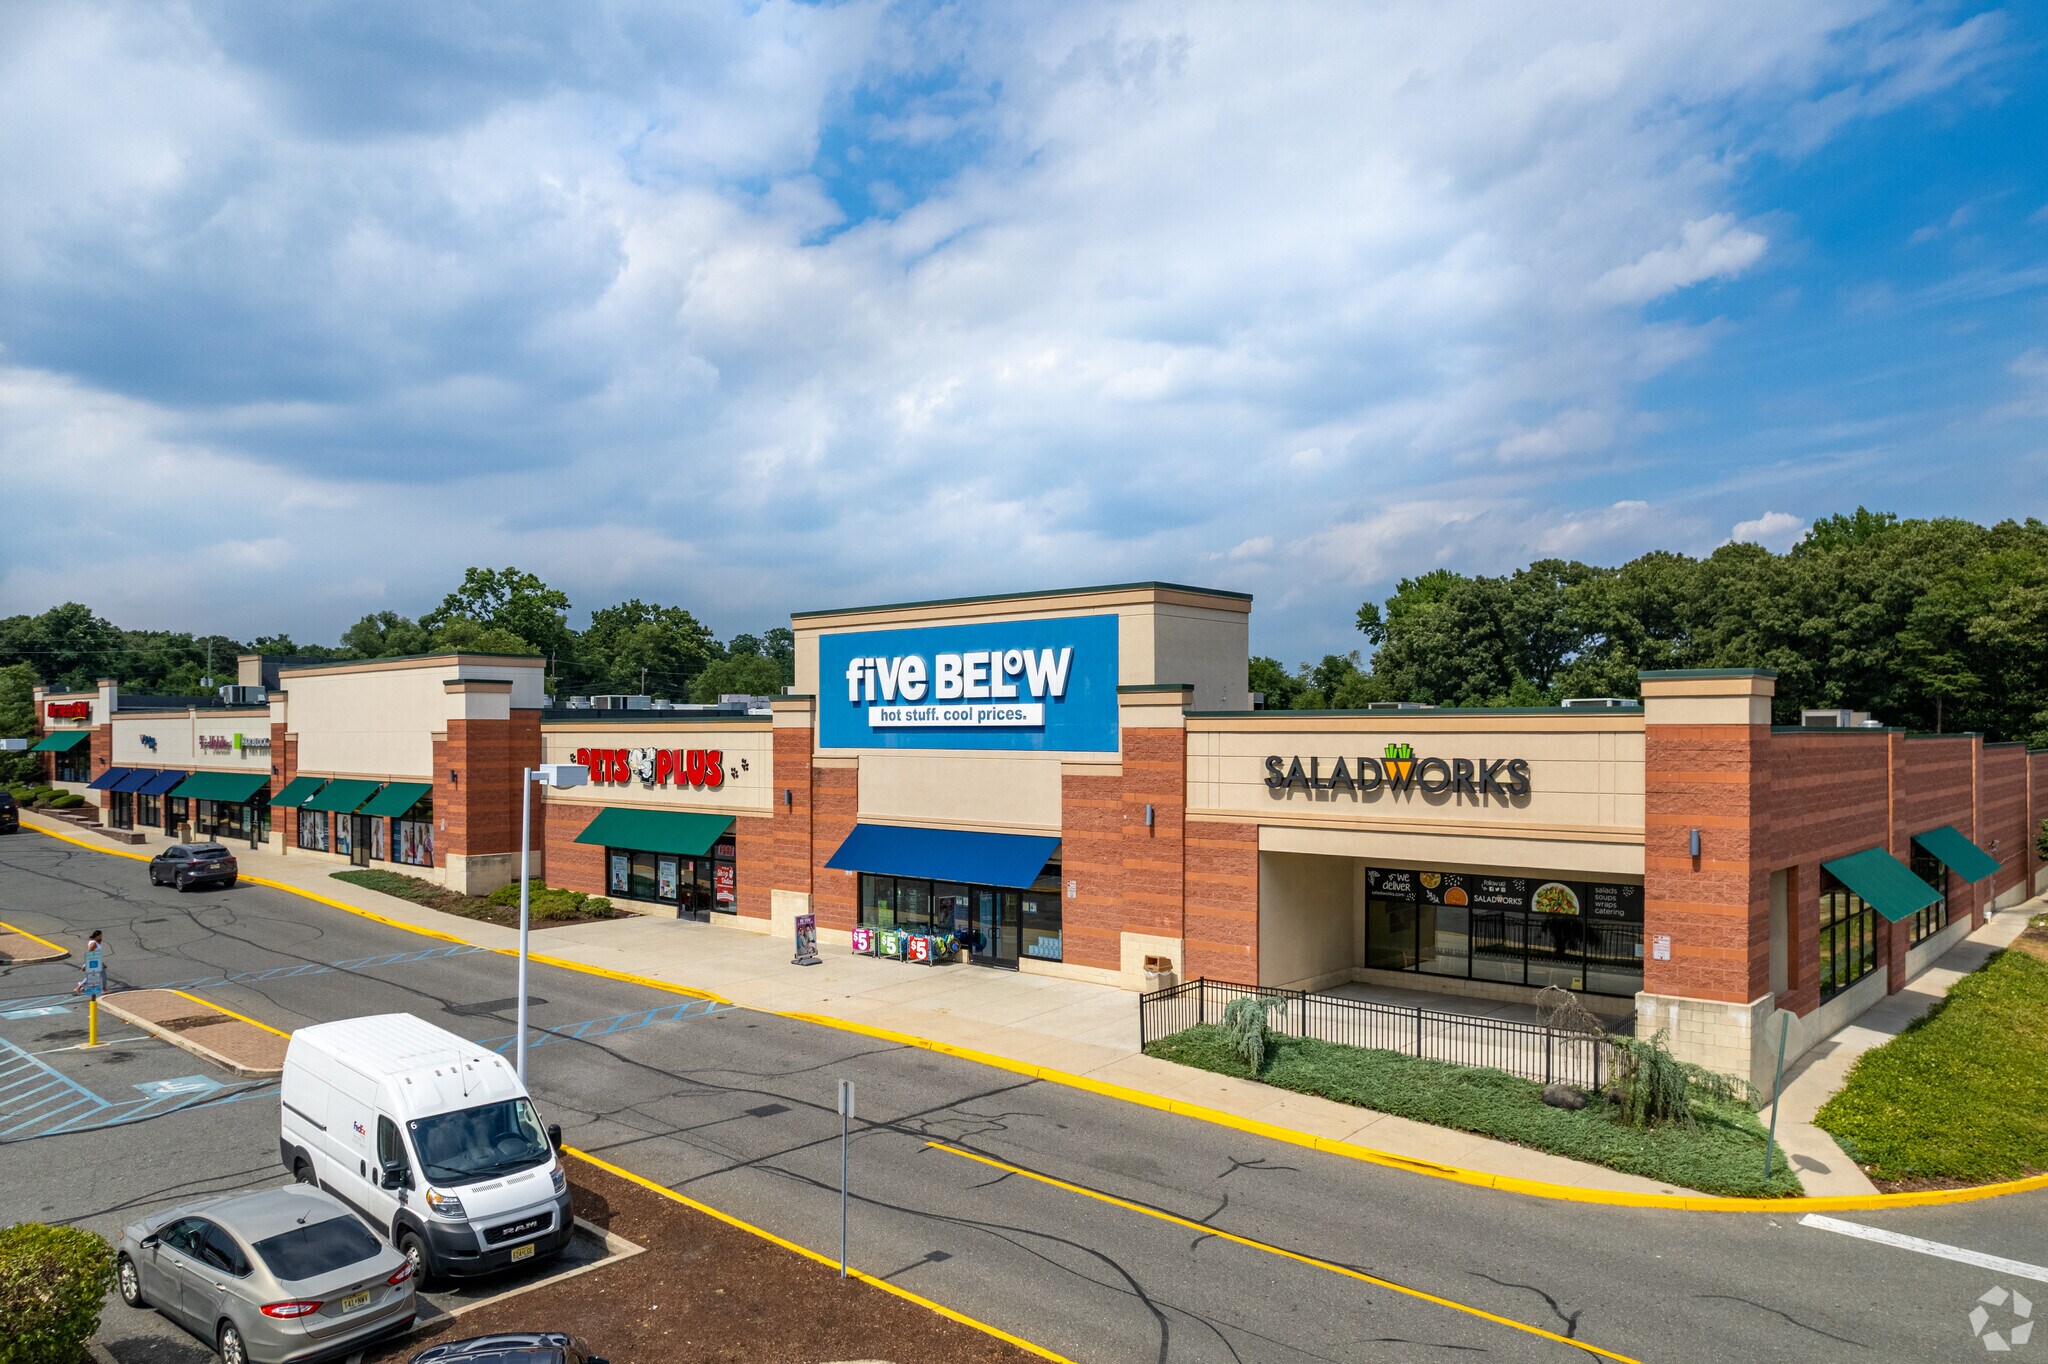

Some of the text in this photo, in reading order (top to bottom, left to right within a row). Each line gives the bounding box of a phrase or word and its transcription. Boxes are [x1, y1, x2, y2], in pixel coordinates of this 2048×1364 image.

[846, 647, 1074, 701] five BELOW
[880, 706, 1027, 724] hot stuff. cool prices.
[656, 749, 724, 787] PLUS
[1264, 755, 1530, 796] SALADWORKS
[1396, 873, 1410, 882] we
[1594, 887, 1618, 895] salads
[1594, 894, 1617, 902] soups
[1473, 894, 1523, 906] SALADWORKS
[1594, 901, 1618, 909] wraps
[1594, 908, 1625, 917] catering
[853, 931, 868, 951] $5
[881, 935, 897, 955] $5
[911, 939, 927, 960] $5
[410, 1121, 418, 1130] 6
[502, 1221, 537, 1235] RAM
